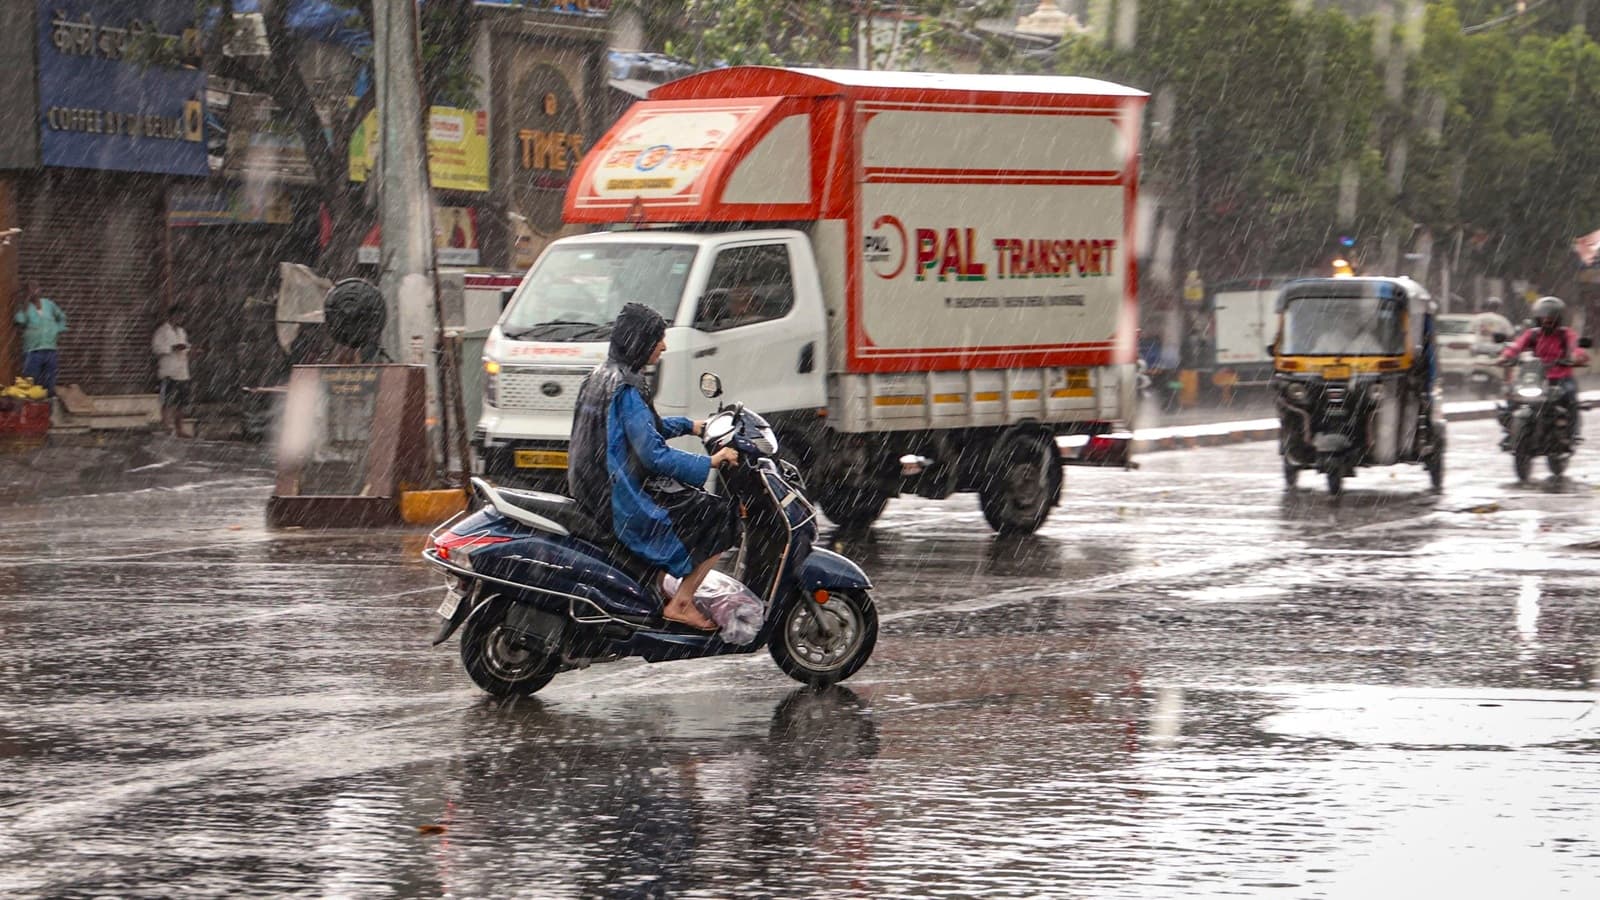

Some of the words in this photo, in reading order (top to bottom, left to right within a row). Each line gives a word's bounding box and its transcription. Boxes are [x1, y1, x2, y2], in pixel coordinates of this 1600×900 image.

[49, 106, 102, 132] COFFEE
[915, 228, 988, 281] PAL
[992, 238, 1117, 279] TRANSPORT
